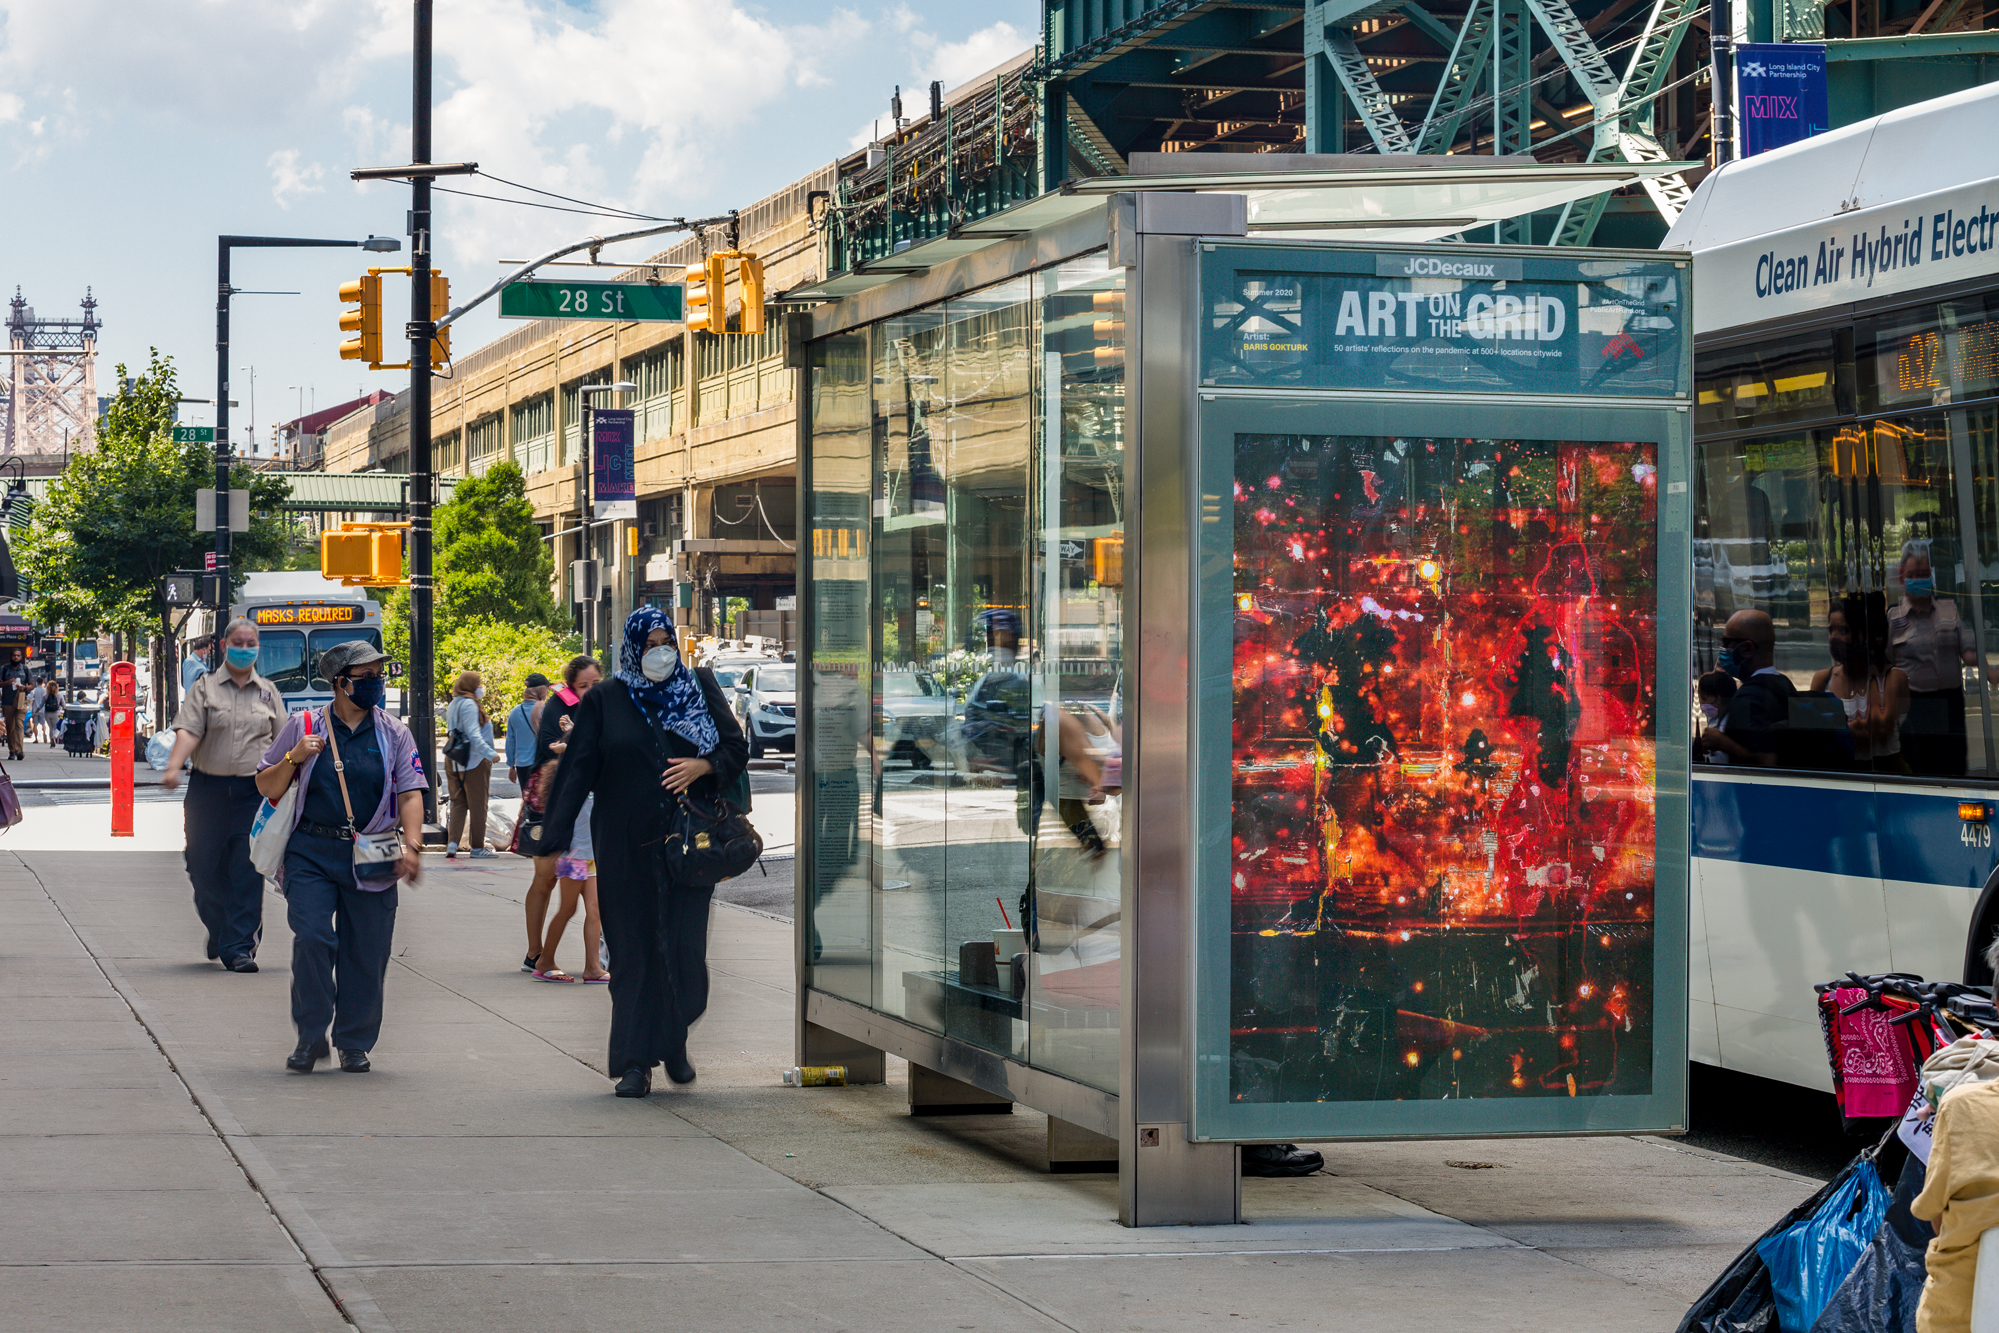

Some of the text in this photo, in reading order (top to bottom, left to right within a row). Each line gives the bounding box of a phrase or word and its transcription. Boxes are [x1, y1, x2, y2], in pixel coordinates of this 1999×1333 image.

[1769, 63, 1820, 72] Long Island City
[1769, 71, 1807, 79] Partnership
[1745, 95, 1798, 119] MIX
[1755, 251, 1808, 298] Clean
[1813, 236, 1845, 287] Air
[1850, 216, 1924, 288] Hybrid
[1404, 258, 1495, 277] JCDecaux
[559, 289, 625, 313] 28 St
[1242, 288, 1294, 297] Summer 2020
[1335, 290, 1566, 341] ART ON THE GRID
[1590, 306, 1646, 315] PublicArtFund.org
[1243, 332, 1270, 341] Artist:
[1601, 329, 1628, 358] PUBLIC
[1955, 320, 1999, 354] JACKS
[1243, 343, 1309, 352] BARIS GOKTURK
[1334, 344, 1344, 352] 50
[1345, 344, 1370, 352] artists'
[1371, 345, 1409, 353] reflections
[1422, 346, 1434, 354] the
[1435, 346, 1471, 356] pandemic
[1472, 347, 1480, 355] at
[1481, 348, 1499, 356] 500+
[1500, 348, 1532, 357] locations
[1533, 349, 1563, 358] citywide
[1612, 341, 1628, 360] ART
[1625, 335, 1645, 359] FUND
[1953, 352, 1999, 383] NORTHE
[180, 428, 196, 441] 28
[596, 431, 621, 443] MIX
[597, 482, 635, 494] MAKE
[257, 607, 353, 624] MASKS REQUIRED
[1960, 823, 1991, 848] 4479
